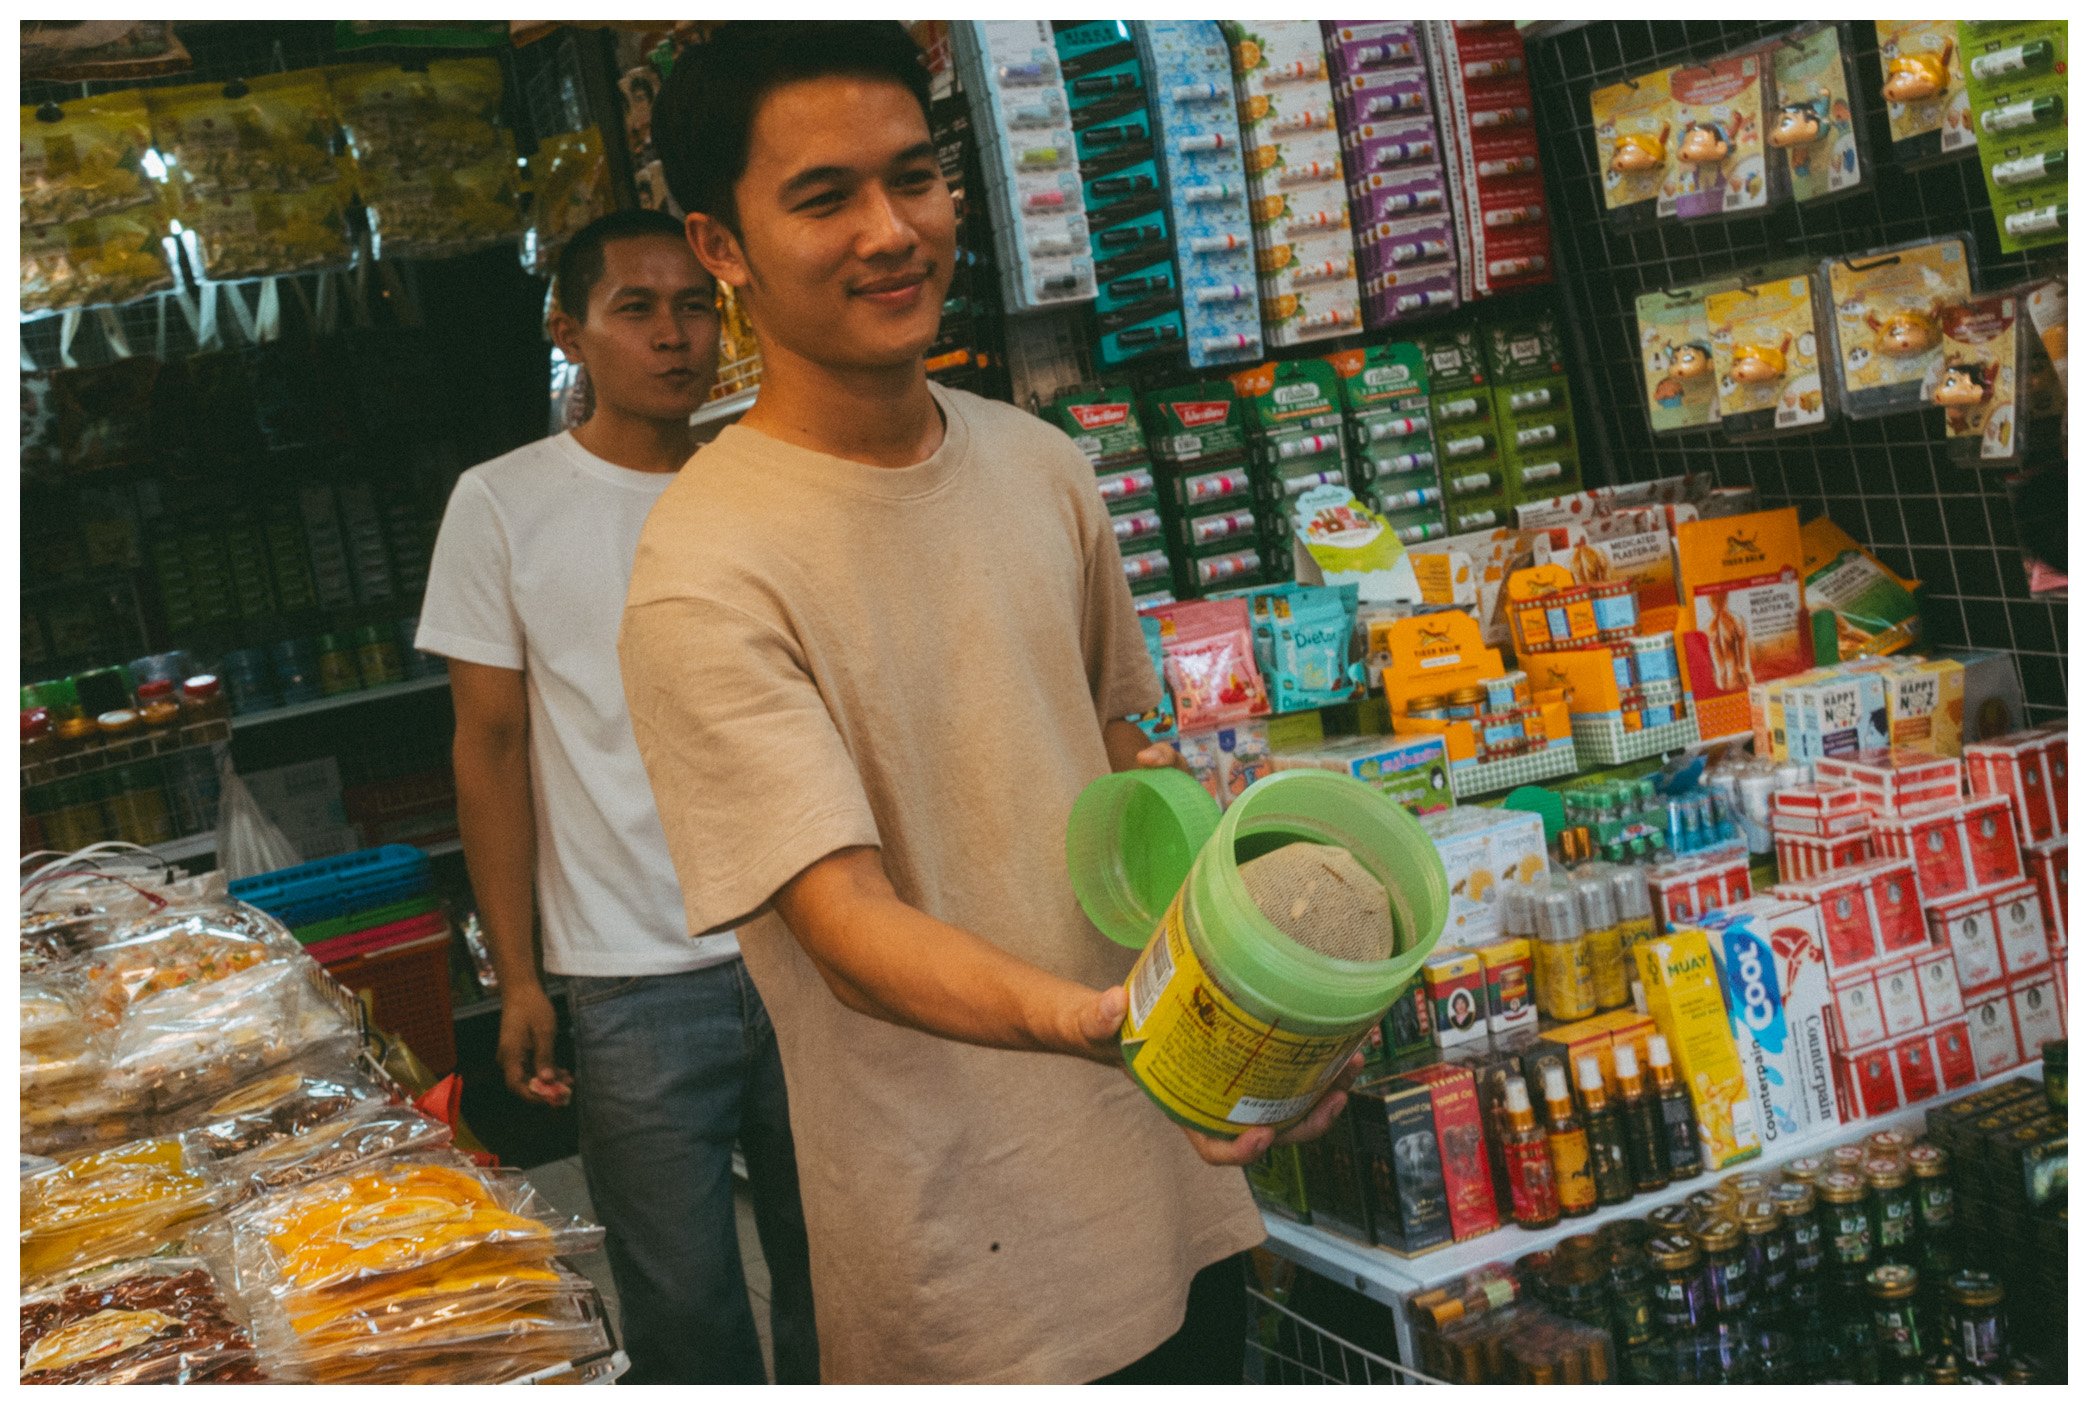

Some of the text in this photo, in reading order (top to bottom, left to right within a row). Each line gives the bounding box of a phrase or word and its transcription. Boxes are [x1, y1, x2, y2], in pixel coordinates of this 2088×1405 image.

[1610, 534, 1657, 550] MEDICATED
[1413, 644, 1461, 658] TIGER BALM
[1900, 680, 1934, 696] HAPPY
[1823, 691, 1856, 706] HAPPY
[1667, 954, 1707, 978] MUAY
[1738, 941, 1774, 1031] COOL
[1806, 1014, 1833, 1121] Counterpain
[1751, 1038, 1778, 1141] Counterpain
